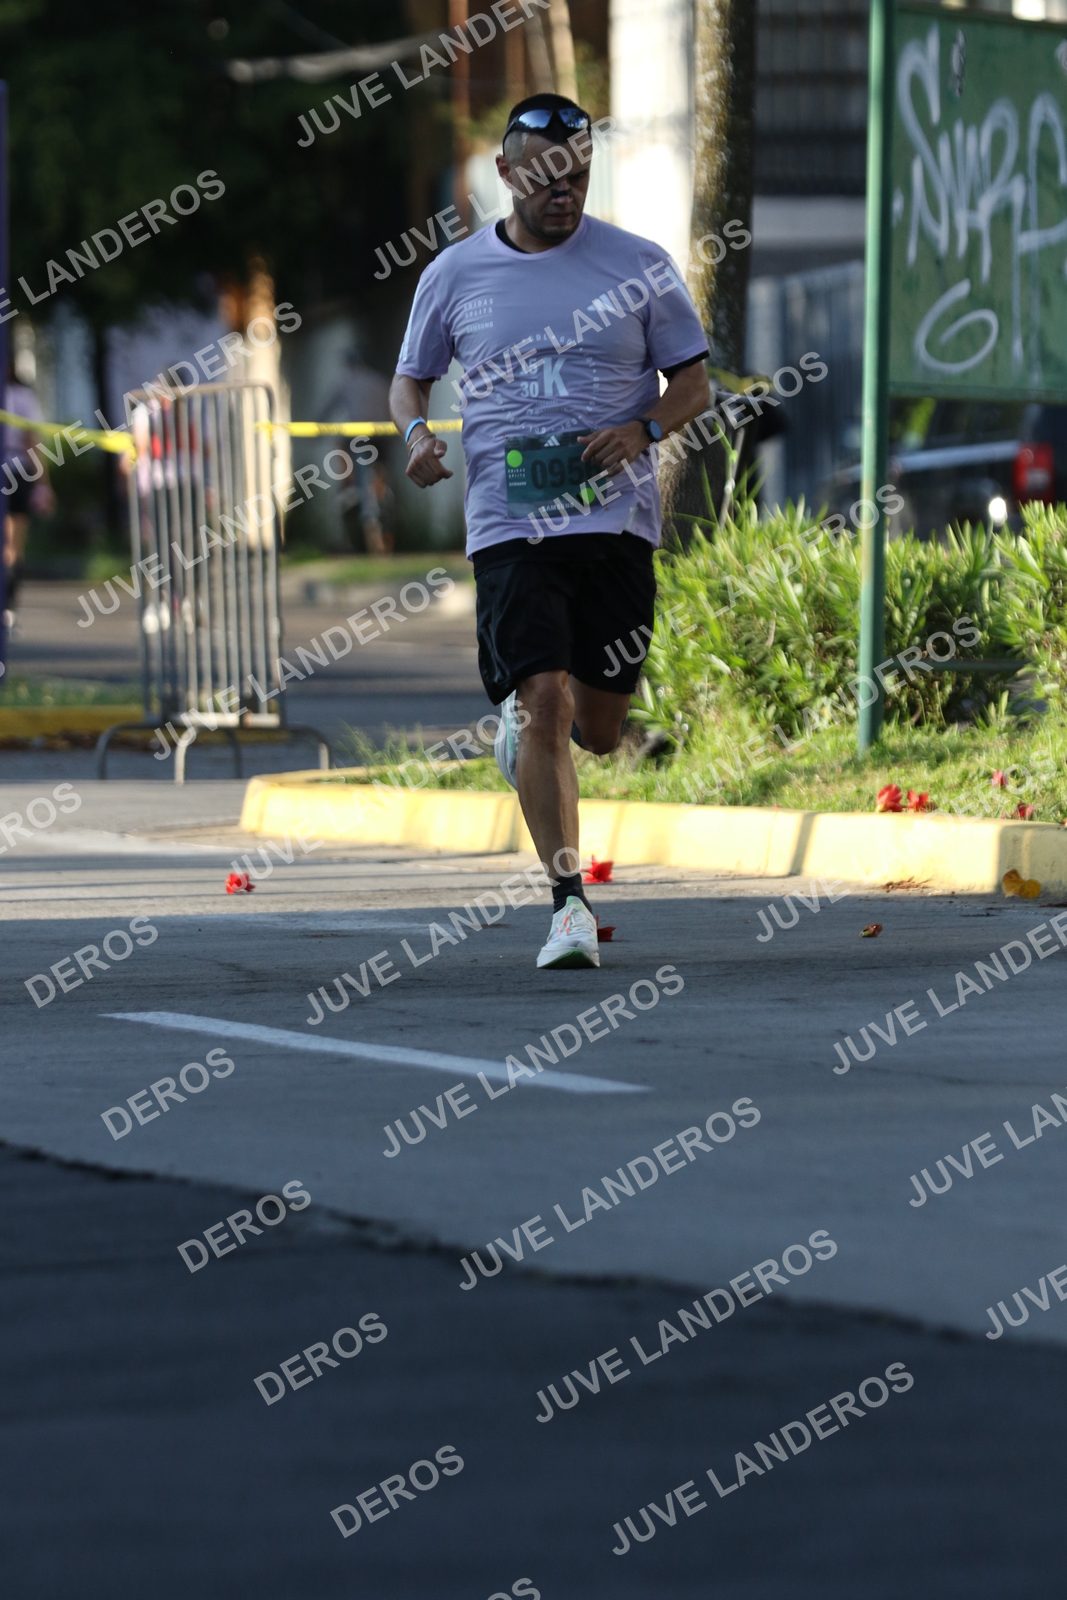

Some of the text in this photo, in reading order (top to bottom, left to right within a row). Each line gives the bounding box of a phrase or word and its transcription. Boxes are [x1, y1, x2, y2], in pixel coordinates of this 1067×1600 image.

[520, 381, 539, 398] 30
[543, 356, 569, 397] K
[531, 456, 592, 490] 095
